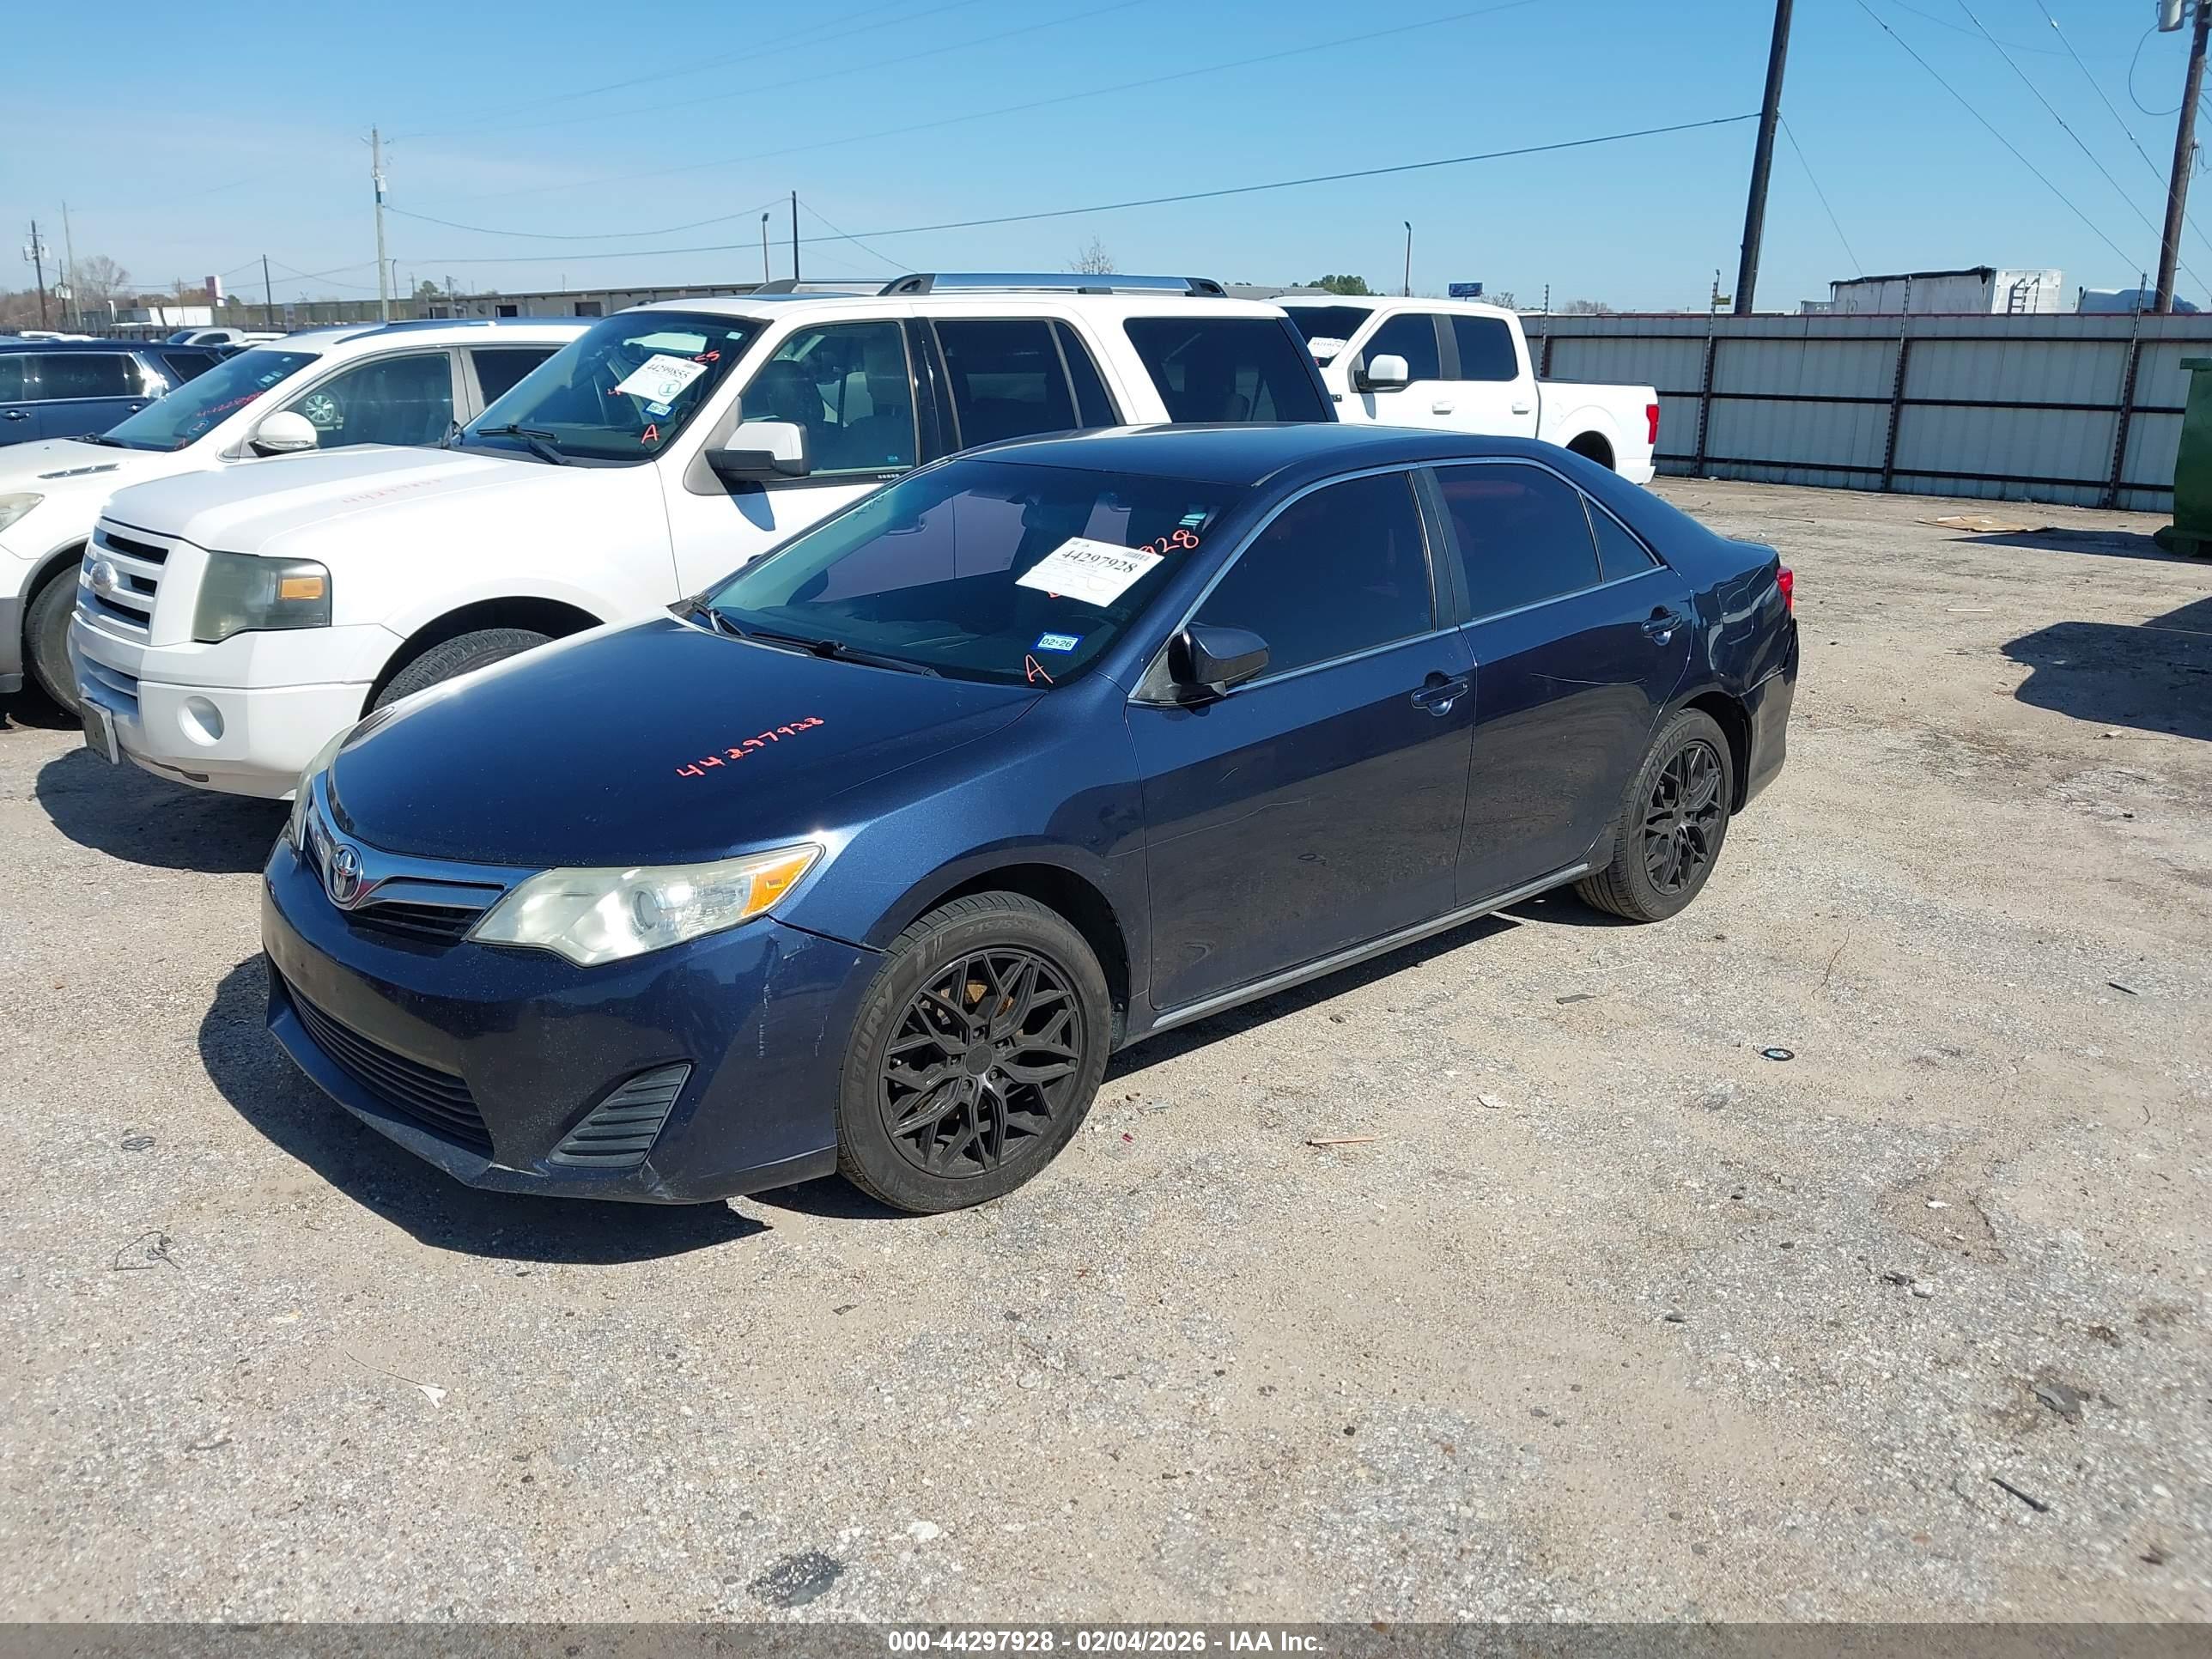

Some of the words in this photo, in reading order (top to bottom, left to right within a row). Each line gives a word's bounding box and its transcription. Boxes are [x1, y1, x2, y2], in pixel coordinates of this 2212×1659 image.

[641, 424, 659, 444] A
[1061, 550, 1138, 574] 44297928
[1024, 654, 1054, 684] A
[677, 717, 824, 776] 44297928
